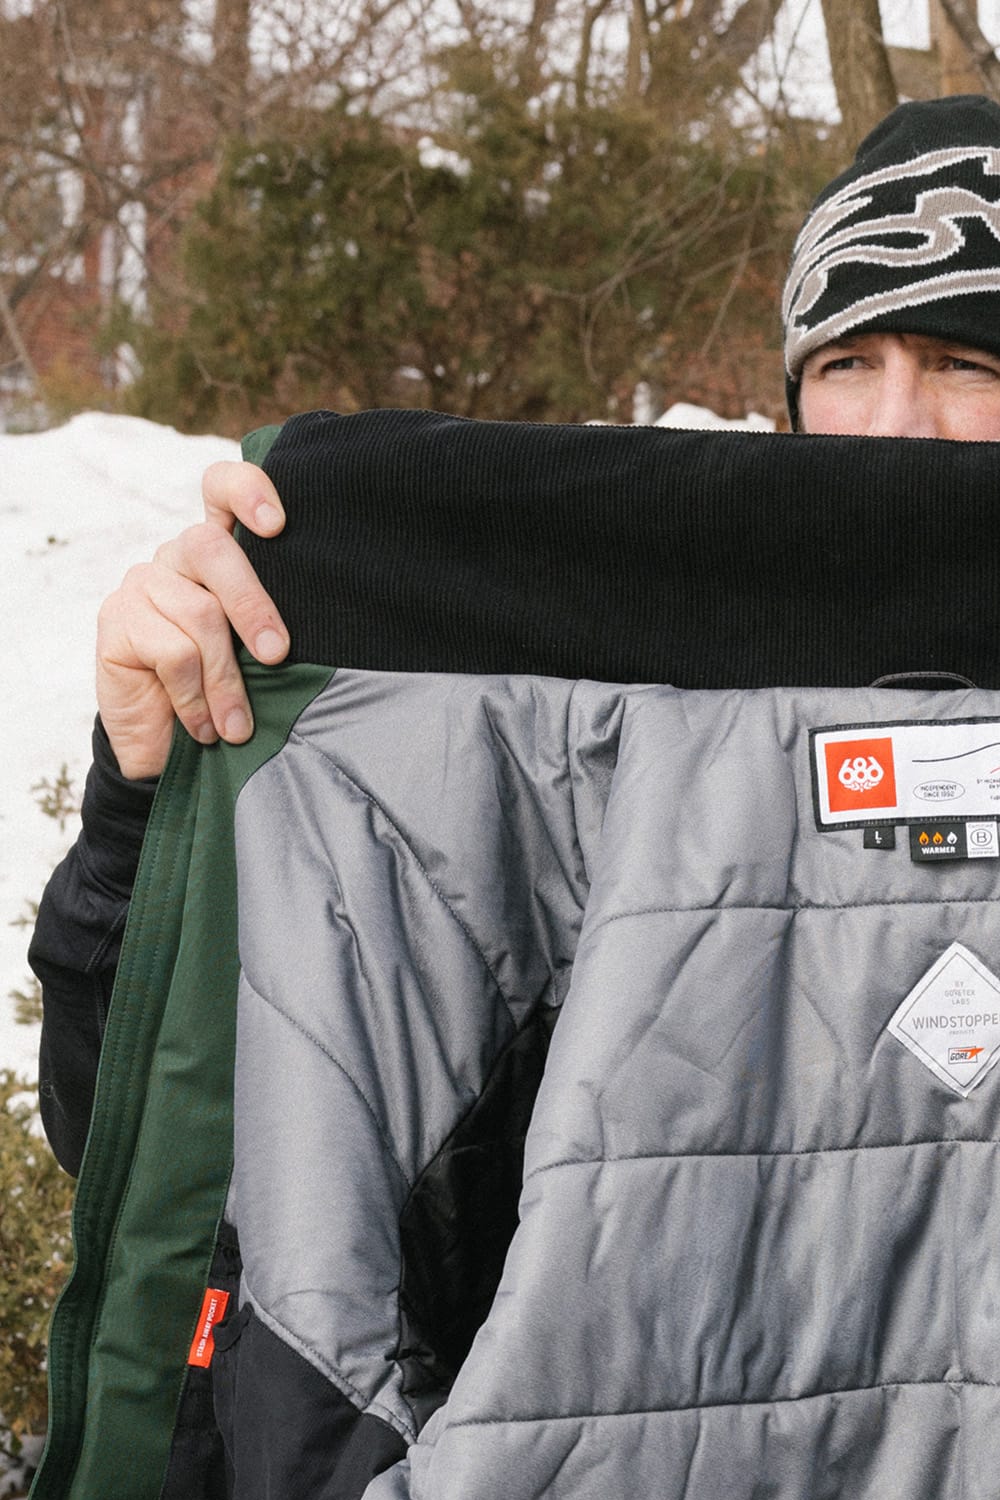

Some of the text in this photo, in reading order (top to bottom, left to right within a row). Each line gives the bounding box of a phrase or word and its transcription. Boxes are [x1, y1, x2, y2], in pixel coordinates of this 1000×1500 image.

[838, 756, 884, 787] 686
[923, 790, 939, 798] SINCE
[976, 831, 987, 843] B
[921, 846, 955, 855] WARMER
[950, 1052, 968, 1061] GORE
